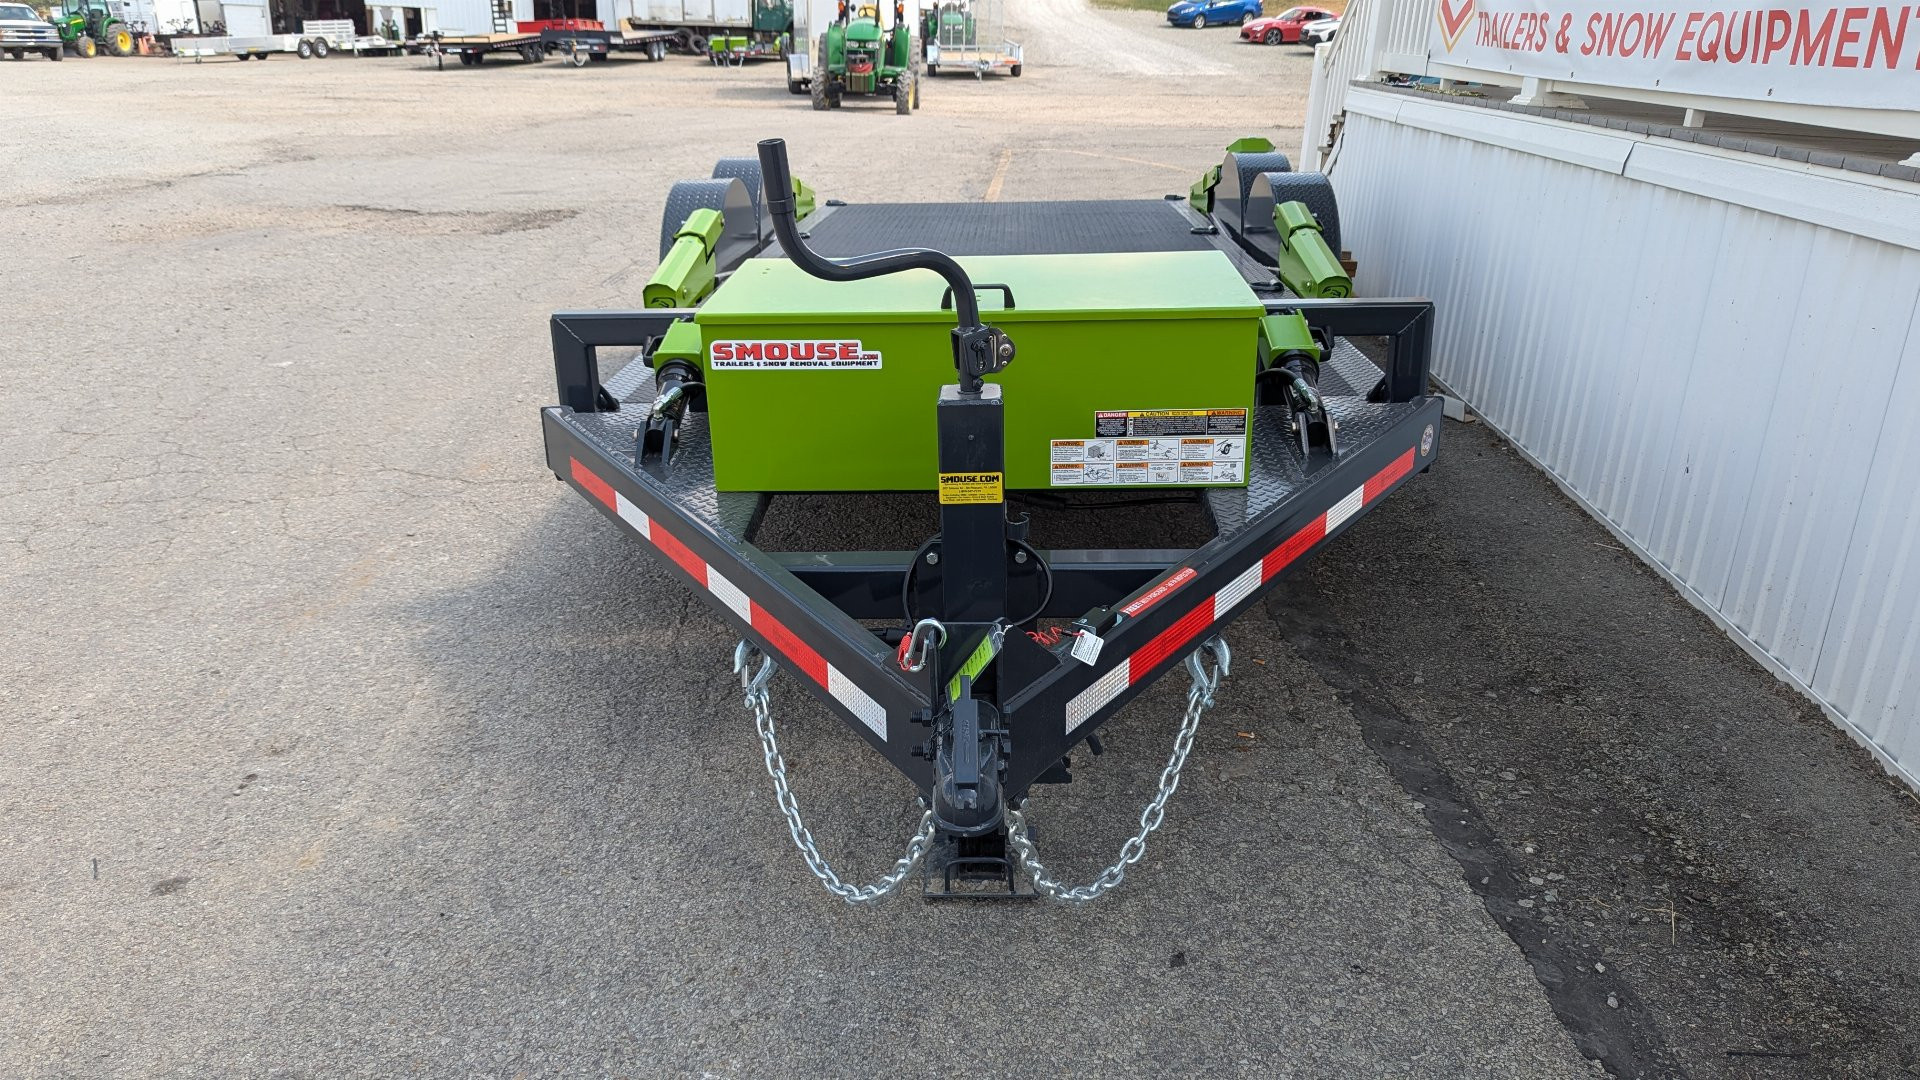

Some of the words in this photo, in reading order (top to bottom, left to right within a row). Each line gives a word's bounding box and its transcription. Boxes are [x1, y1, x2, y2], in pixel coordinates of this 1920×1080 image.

[1476, 11, 1549, 52] TRAILERS
[1555, 12, 1572, 54] &
[1580, 12, 1676, 58] SNOW
[1675, 6, 1920, 71] EQUIPMEN
[941, 475, 999, 483] SMOUSE.COM
